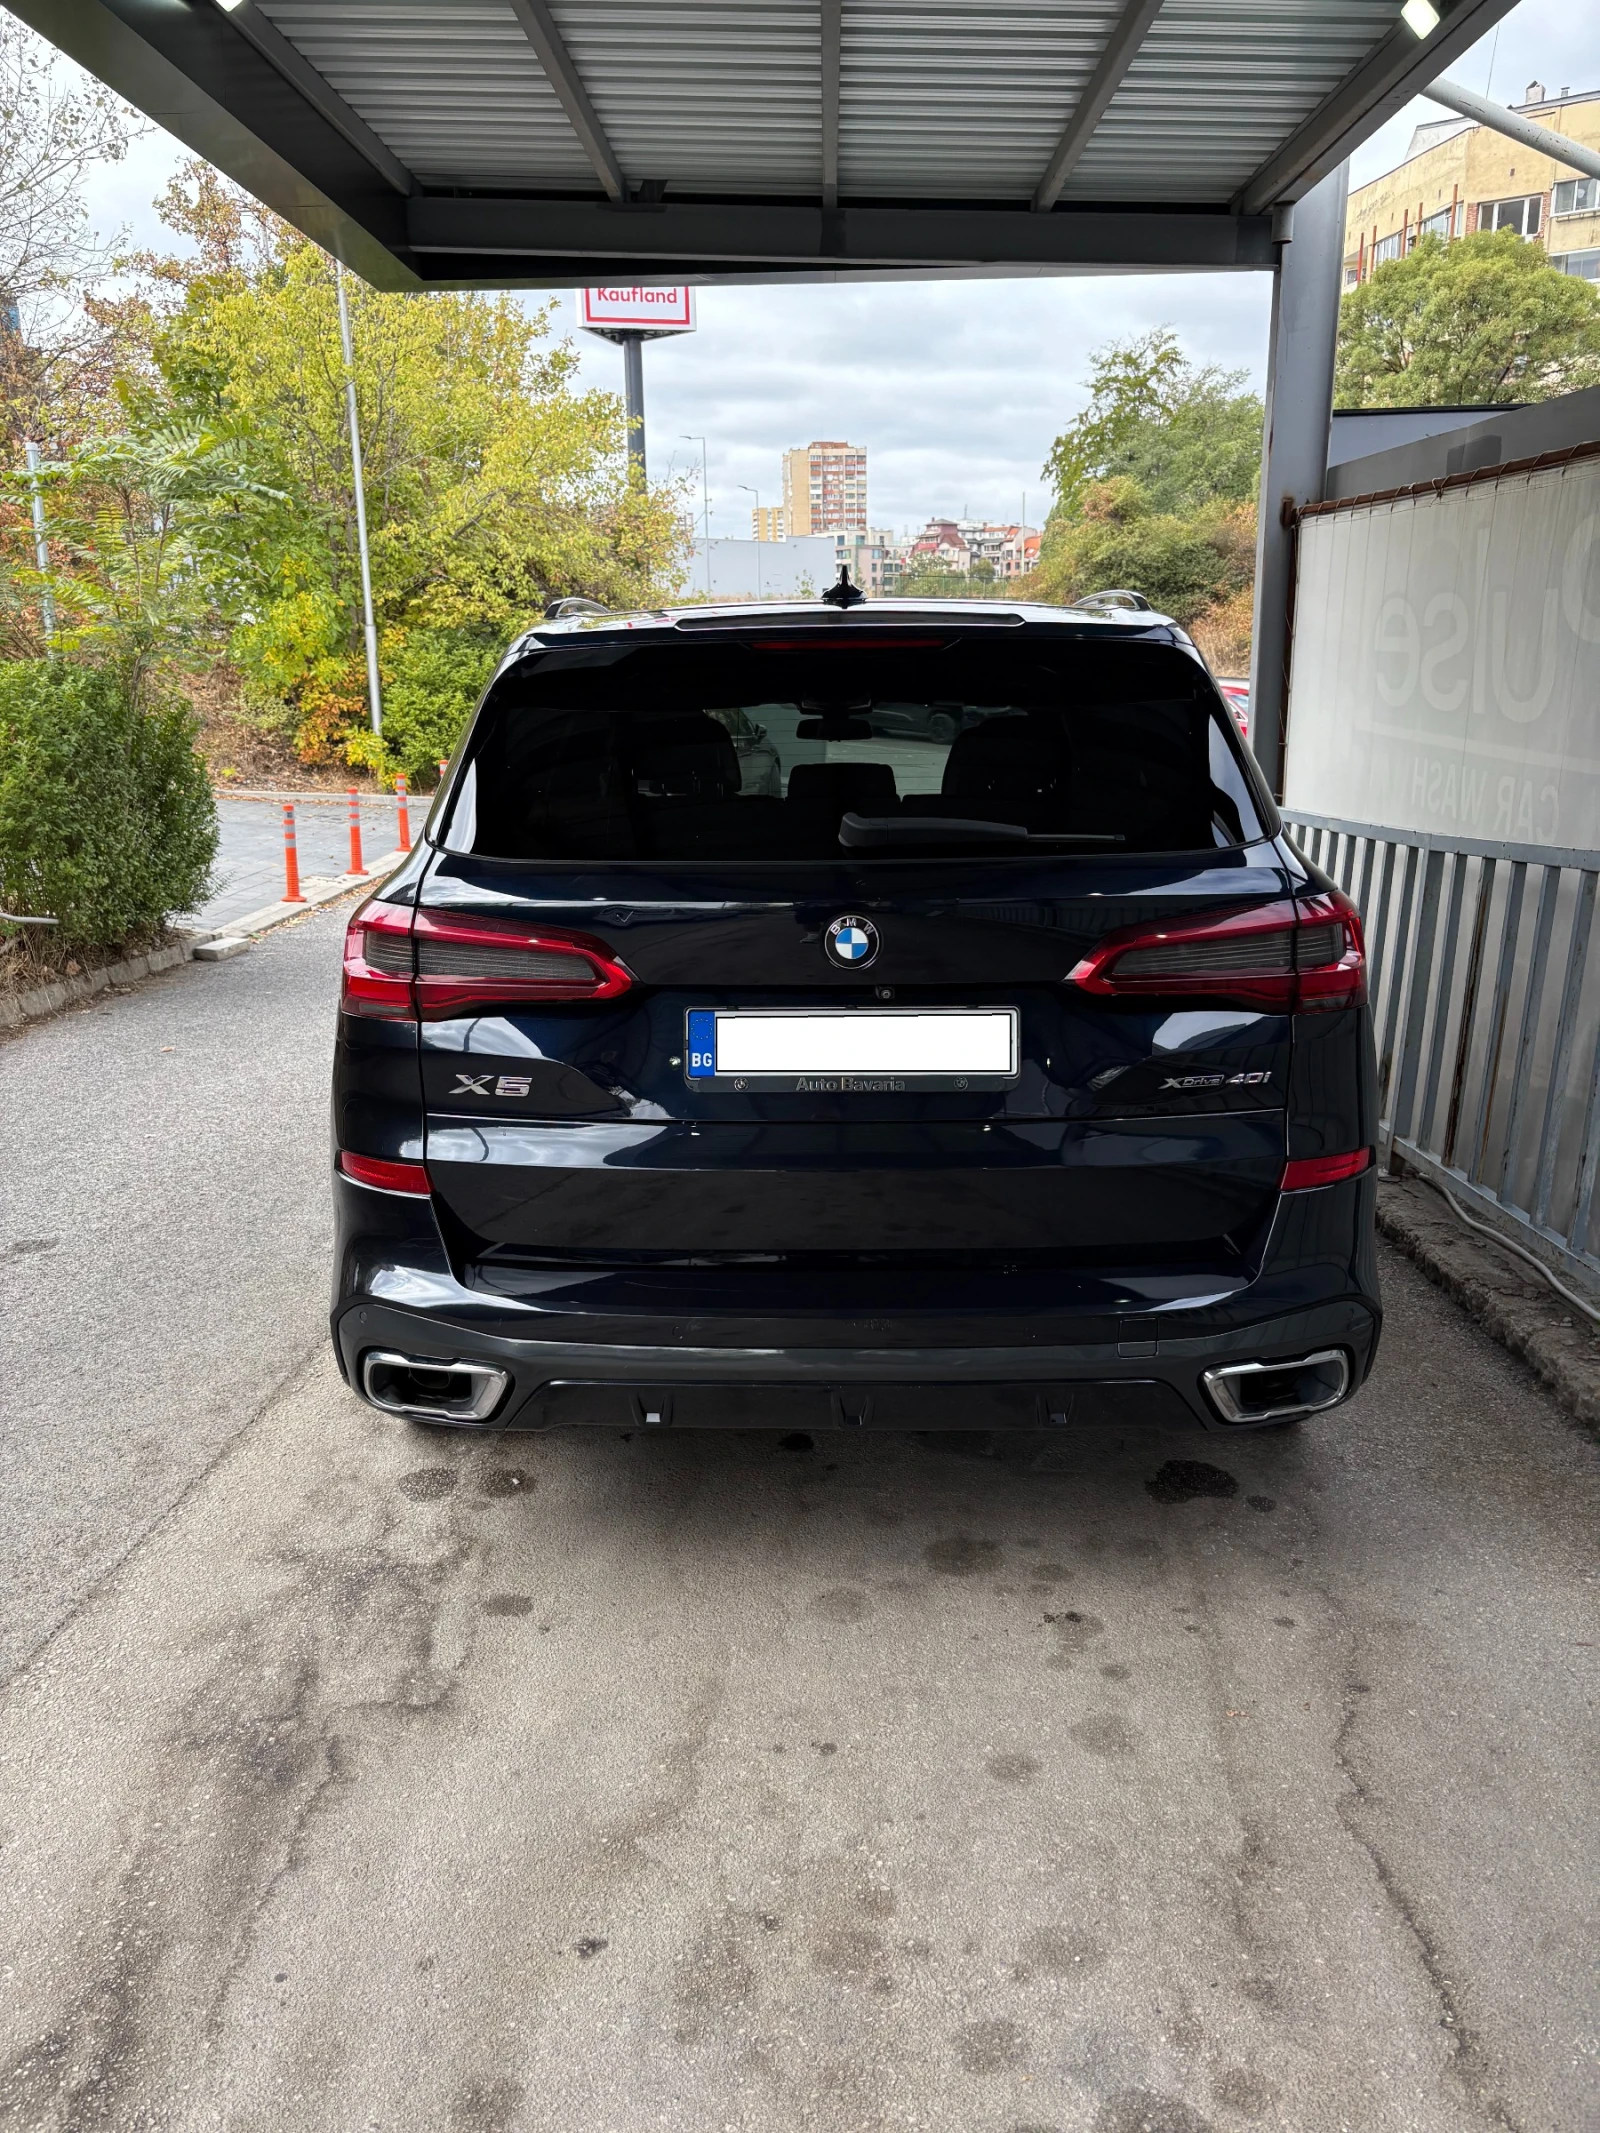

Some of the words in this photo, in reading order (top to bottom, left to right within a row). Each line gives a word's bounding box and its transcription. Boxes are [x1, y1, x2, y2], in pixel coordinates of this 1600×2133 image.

[598, 287, 677, 303] Kaufland
[830, 918, 875, 935] BMW
[692, 1053, 712, 1067] BG
[448, 1074, 533, 1097] X5
[796, 1077, 837, 1091] Auto
[841, 1077, 905, 1091] Bavaria
